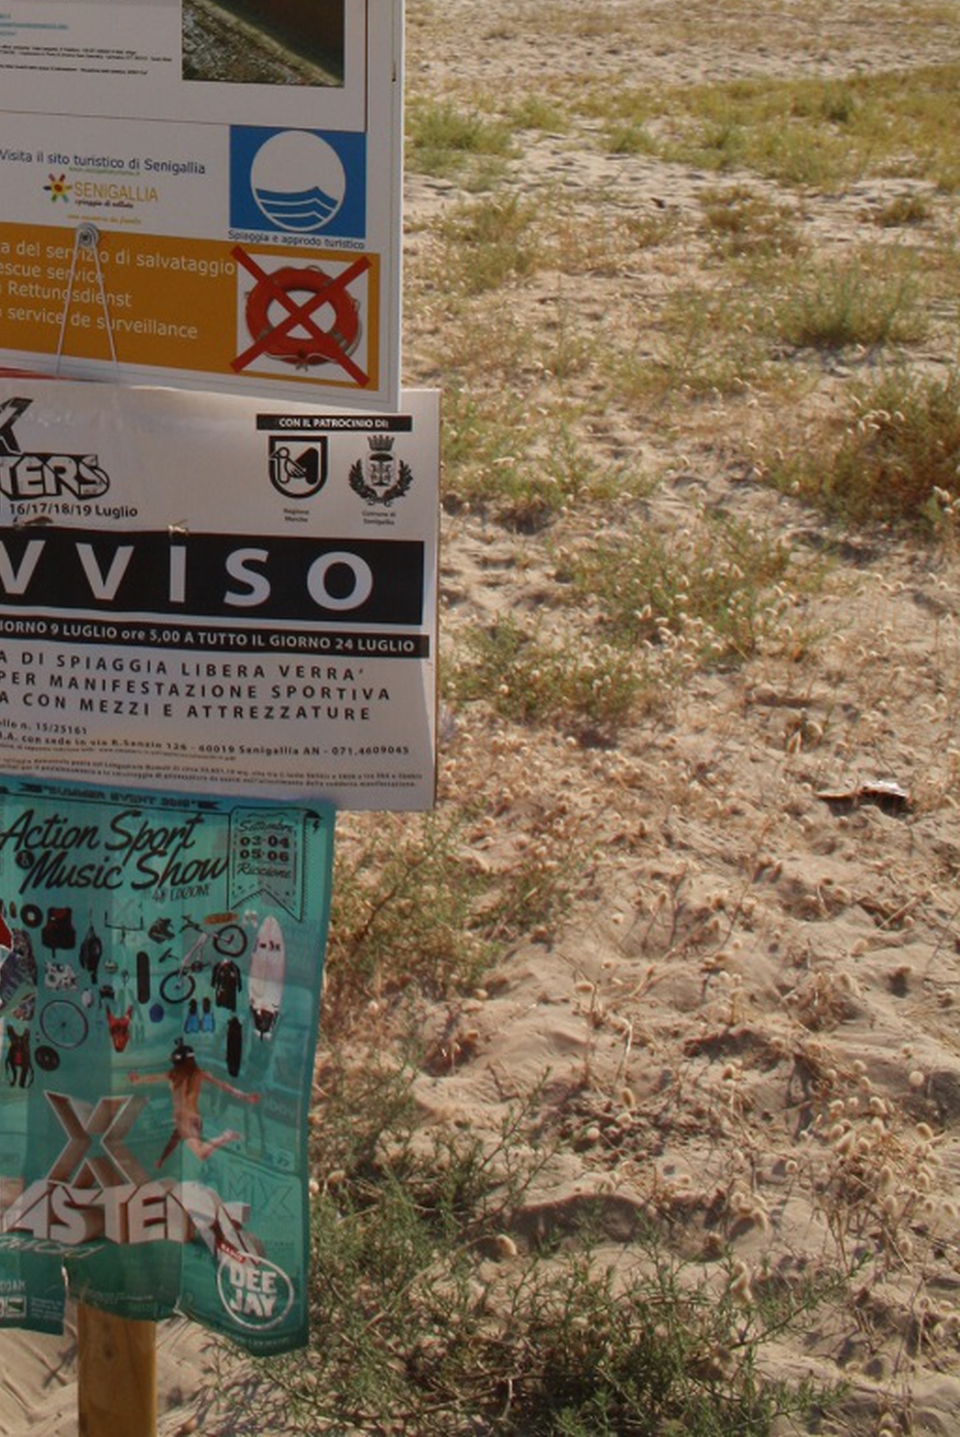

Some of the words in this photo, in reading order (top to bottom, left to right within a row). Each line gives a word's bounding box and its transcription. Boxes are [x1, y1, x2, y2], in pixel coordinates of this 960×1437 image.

[47, 152, 70, 165] sito
[73, 154, 125, 169] turistico
[143, 157, 205, 176] Senigallia
[228, 231, 269, 244] Spiaggia
[281, 236, 322, 247] approdo
[324, 238, 365, 250] turistico
[46, 245, 109, 265] servizio
[136, 253, 236, 277] salvataggio
[47, 266, 104, 283] service
[8, 280, 131, 307] Rettungsdienst
[7, 307, 65, 325] service
[97, 316, 198, 340] surveillance
[313, 418, 373, 428] PATROCINIO
[9, 502, 92, 519] 16/17/18/19
[95, 504, 139, 520] Luglio
[63, 624, 117, 639] LUGLIO
[150, 628, 180, 643] 5,00
[197, 631, 248, 646] TUTTO
[269, 634, 331, 649] GIORNO
[357, 638, 414, 652] LUGLIO
[21, 651, 43, 665] DI
[57, 654, 167, 675] SPIAGGIA
[181, 662, 265, 678] LIBERA
[49, 673, 256, 699] MANIFESTAZIONE
[271, 684, 389, 701] SPORTIVA
[79, 697, 149, 716] MEZZI
[186, 704, 369, 721] ATTREZZATURE
[239, 744, 299, 756] Senigallia
[105, 809, 204, 866] Sport
[18, 852, 122, 894] Music
[131, 847, 230, 890] Show
[43, 1088, 151, 1189] X
[229, 1263, 277, 1294] DEE
[229, 1290, 278, 1318] JAY
